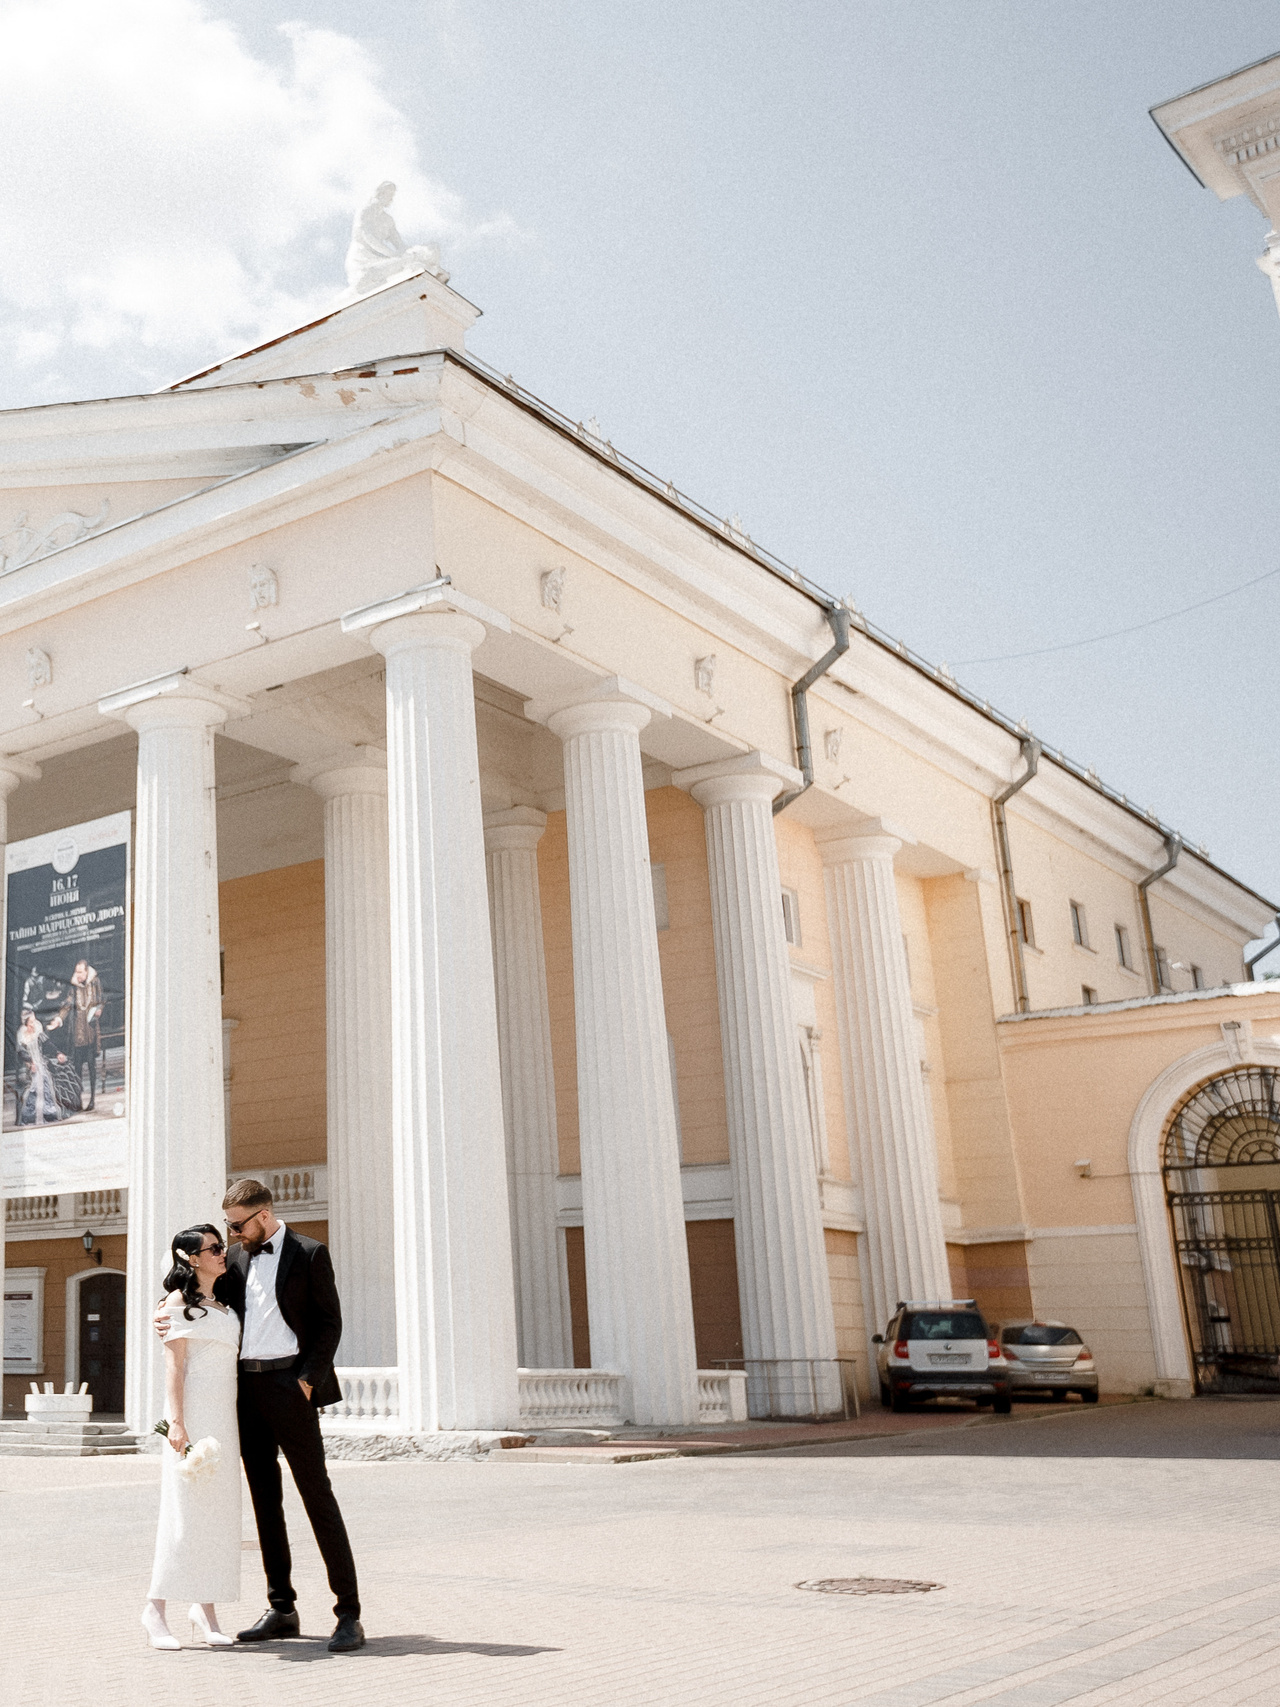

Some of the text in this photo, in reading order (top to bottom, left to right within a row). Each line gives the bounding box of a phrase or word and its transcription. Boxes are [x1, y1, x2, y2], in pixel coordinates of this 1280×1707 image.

[67, 874, 79, 888] 17
[50, 889, 80, 907] ИЮНЯ
[9, 926, 37, 941] ТАЙНЫ
[96, 905, 124, 922] ДВОРА
